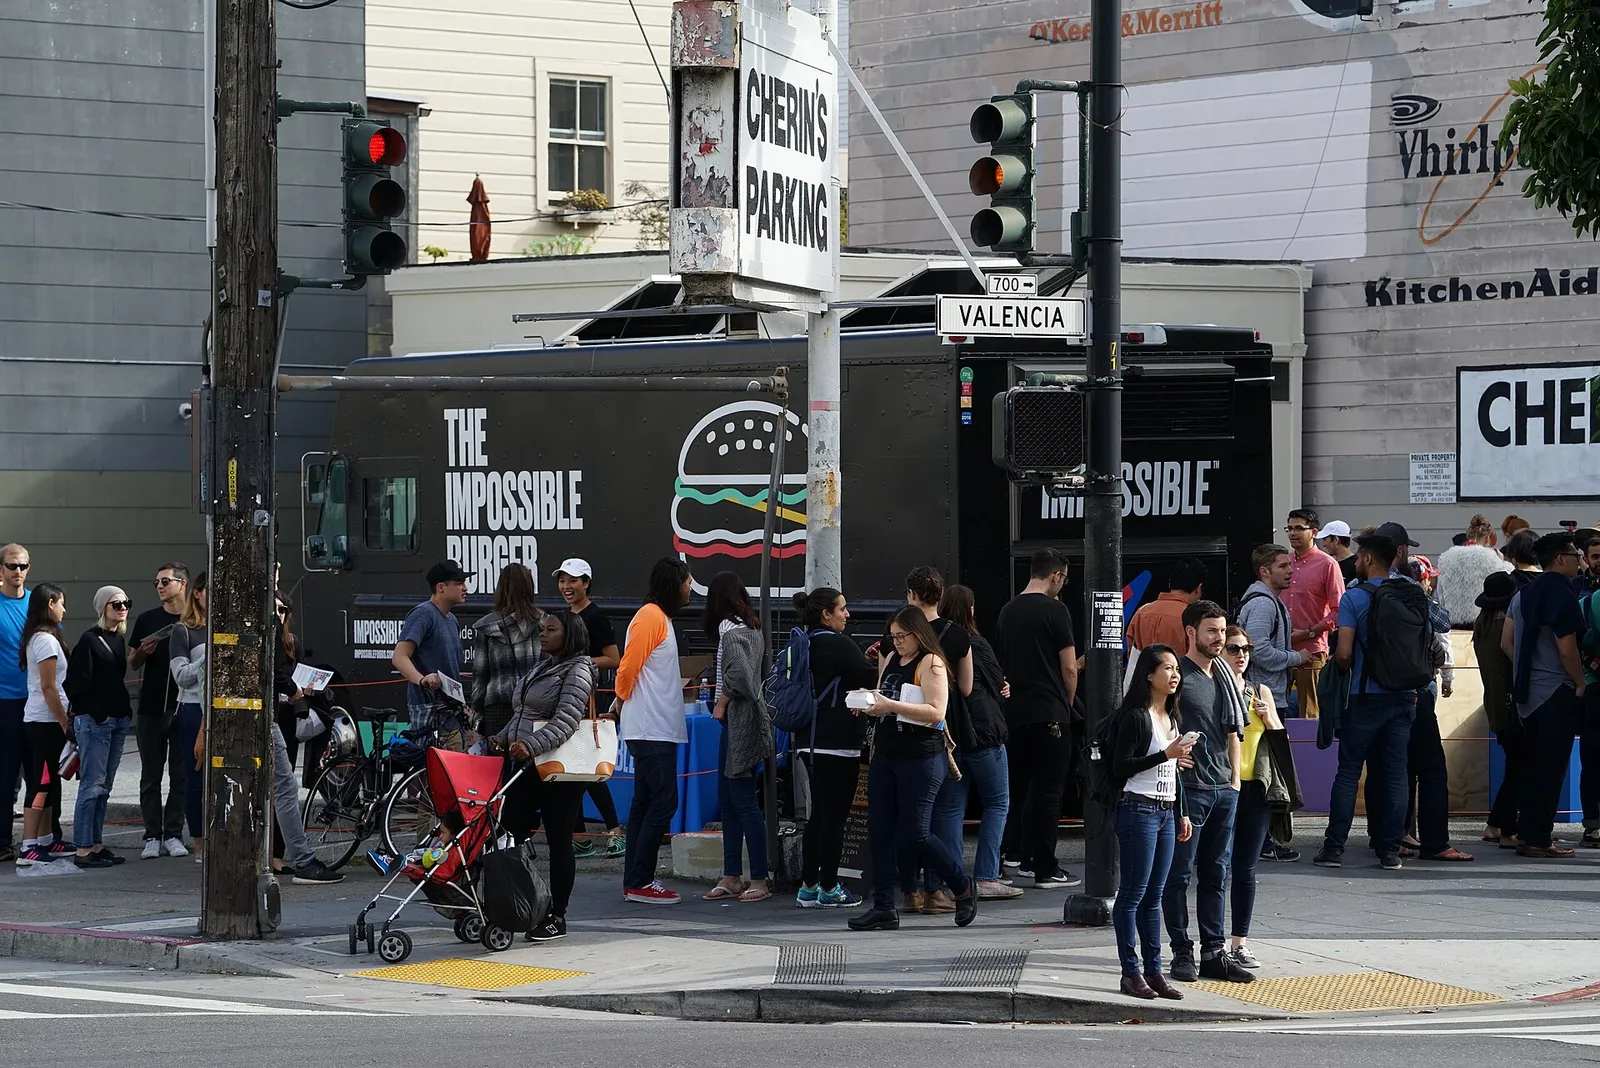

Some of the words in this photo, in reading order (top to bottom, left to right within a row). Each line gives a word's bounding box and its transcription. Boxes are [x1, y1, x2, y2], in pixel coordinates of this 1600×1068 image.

[1029, 18, 1091, 43] O'Kee
[746, 67, 828, 163] CHERIN'S
[746, 165, 828, 253] PARKING
[993, 277, 1019, 292] 700
[1365, 267, 1599, 307] KitchenAid
[959, 304, 1065, 328] VALENCIA
[444, 408, 488, 467] THE
[1431, 453, 1456, 461] PROPERTY
[445, 470, 584, 531] IMPOSSIBLE
